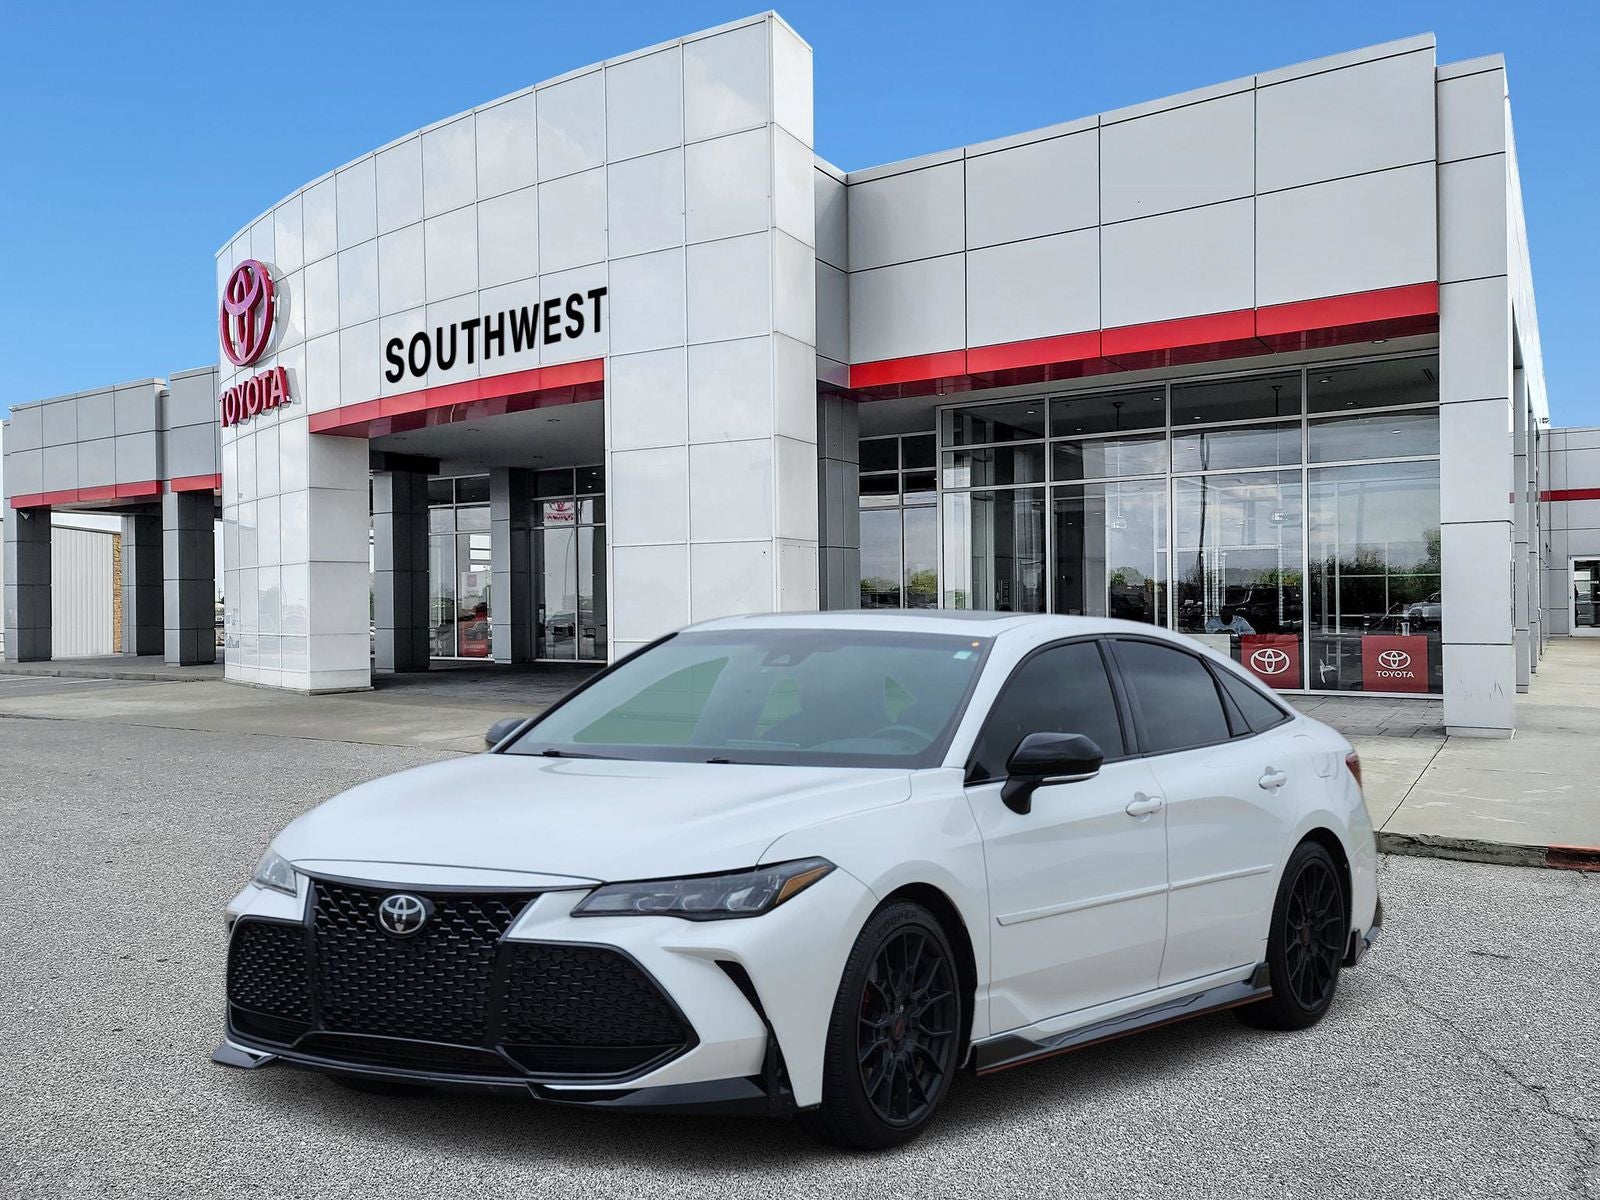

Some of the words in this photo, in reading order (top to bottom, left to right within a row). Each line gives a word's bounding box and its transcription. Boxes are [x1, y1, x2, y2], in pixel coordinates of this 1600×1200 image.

[385, 286, 608, 384] SOUTHWEST
[219, 366, 291, 428] TOYOTA
[1375, 670, 1415, 678] TOYOTA
[875, 911, 918, 937] COOPER
